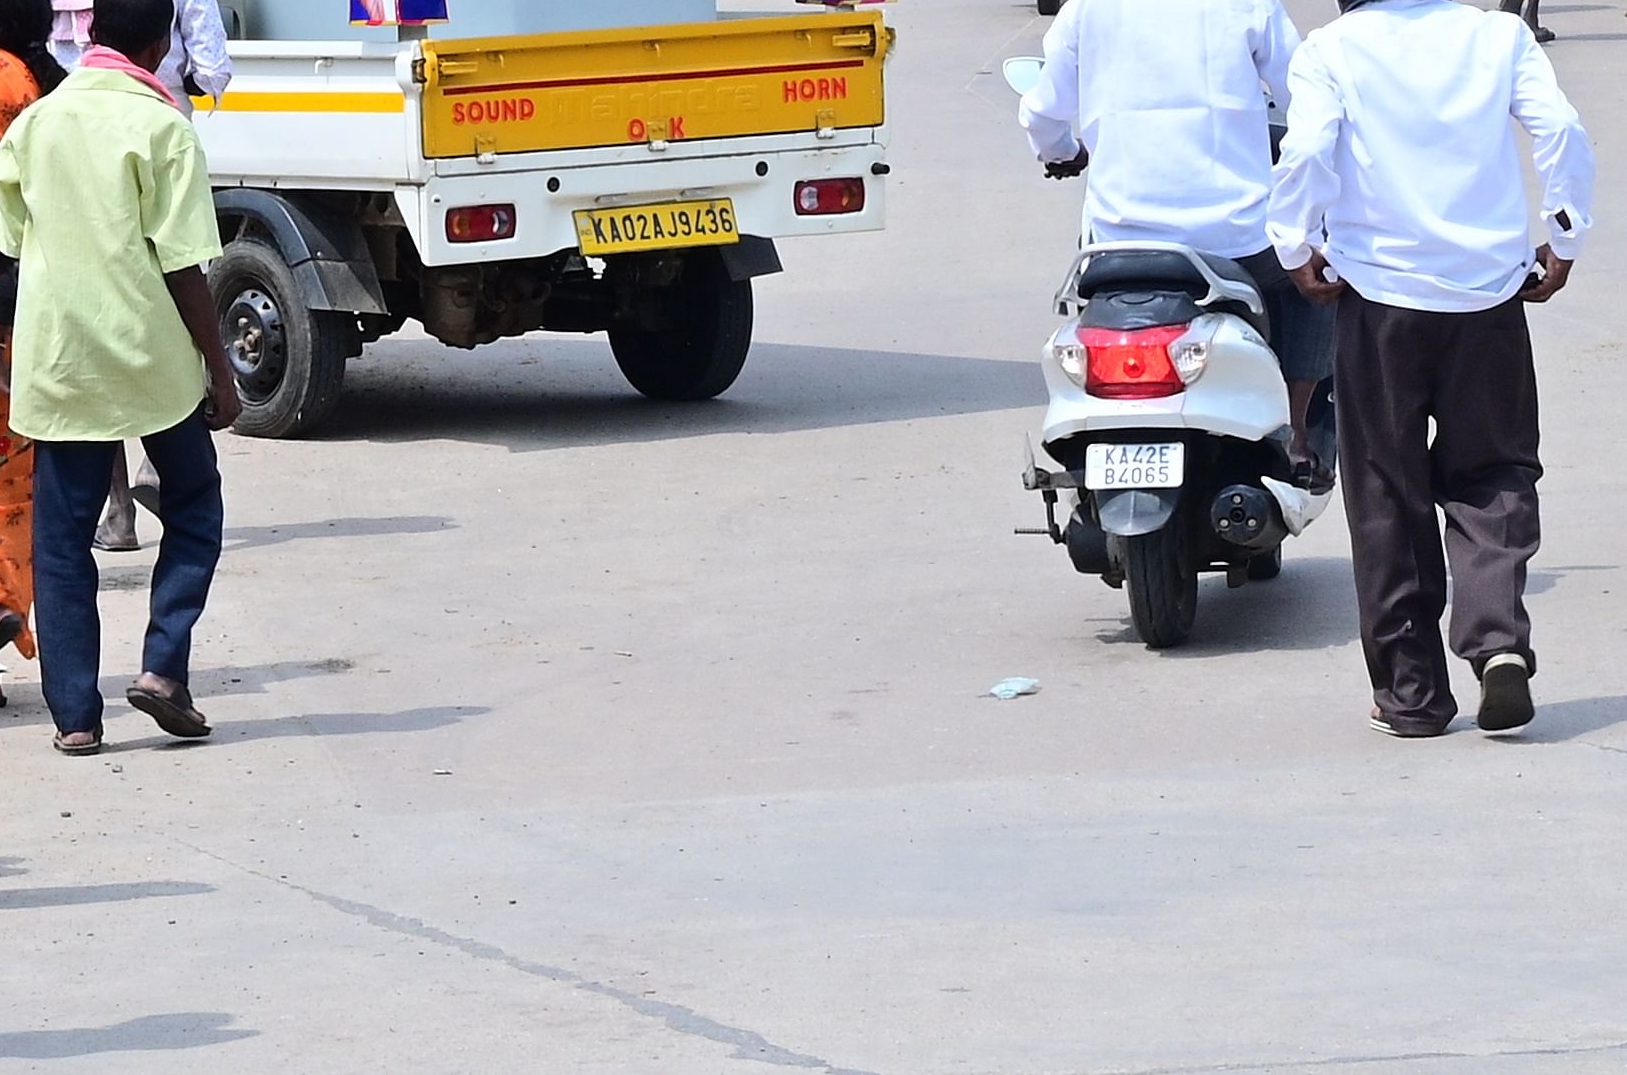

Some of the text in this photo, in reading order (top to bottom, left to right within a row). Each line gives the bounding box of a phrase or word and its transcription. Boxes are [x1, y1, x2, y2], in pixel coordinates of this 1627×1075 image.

[782, 76, 849, 103] HORN
[451, 97, 536, 125] SOUND
[591, 207, 734, 245] KA02AJ9436
[1105, 445, 1170, 465] KA42E
[1104, 466, 1170, 485] B4065
